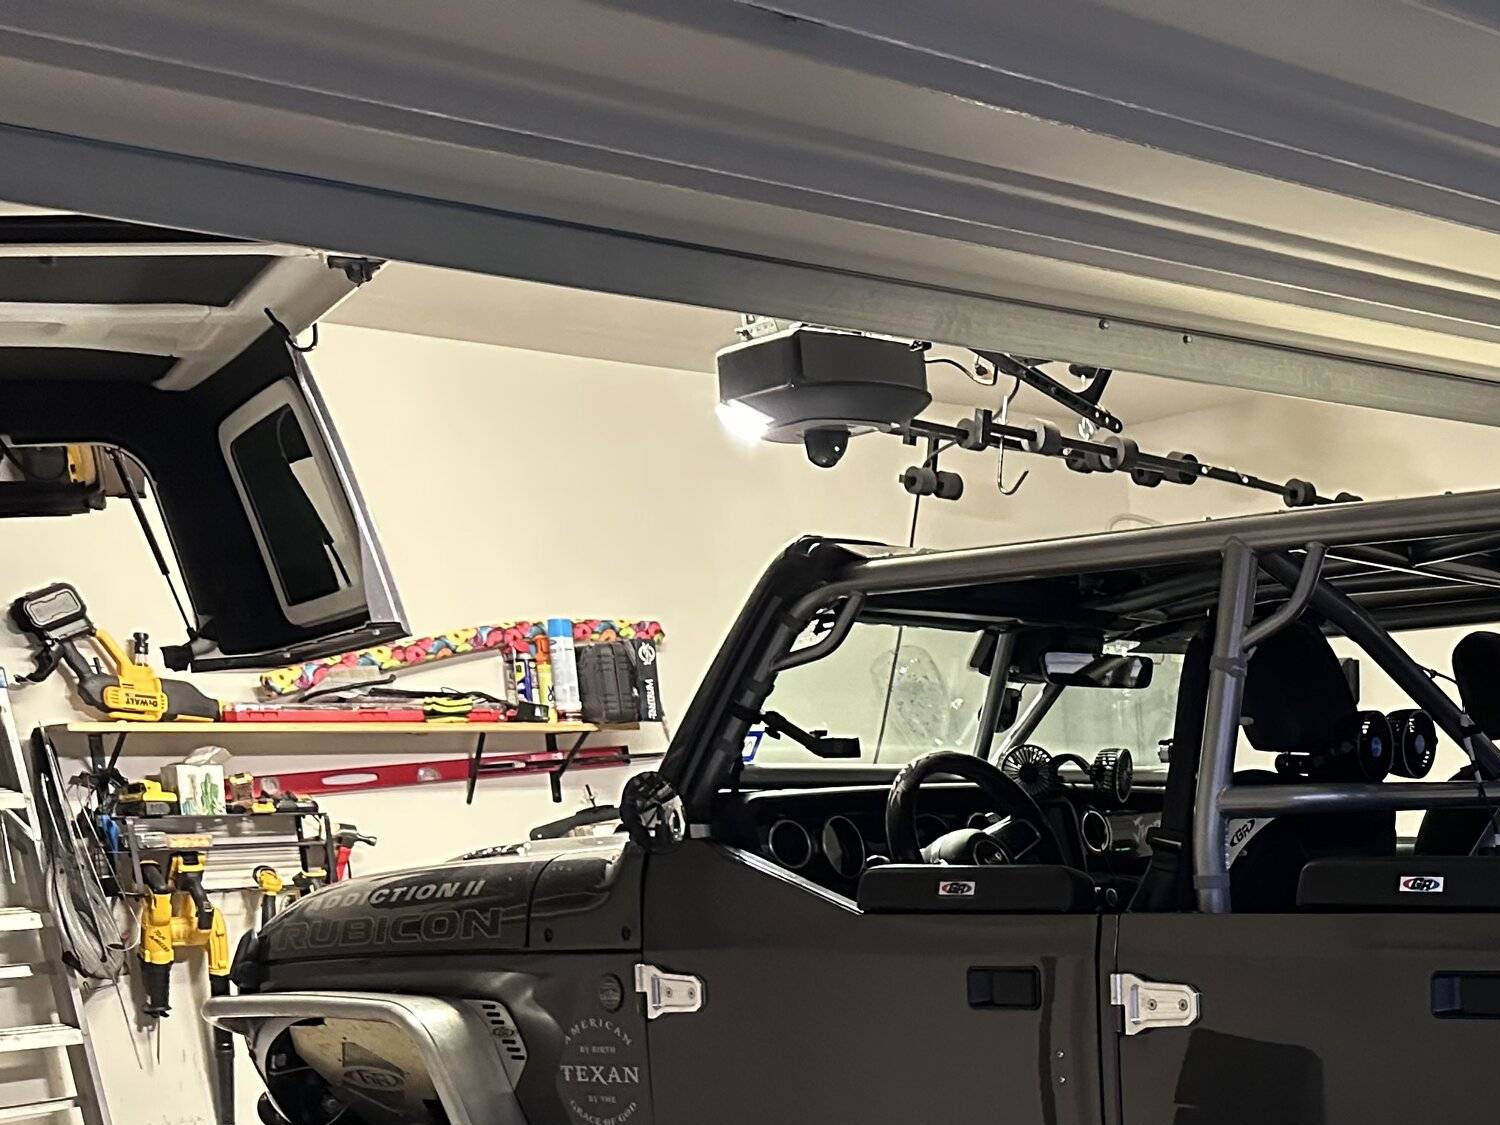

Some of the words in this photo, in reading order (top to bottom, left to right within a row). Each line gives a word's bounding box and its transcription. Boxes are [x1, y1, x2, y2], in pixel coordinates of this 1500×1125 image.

[305, 881, 460, 912] ADDICTION
[463, 879, 486, 897] II
[279, 907, 507, 950] RUBICON
[564, 1018, 632, 1046] AMERICAN
[560, 1065, 640, 1086] TEXAN
[570, 1100, 601, 1125] GRACE
